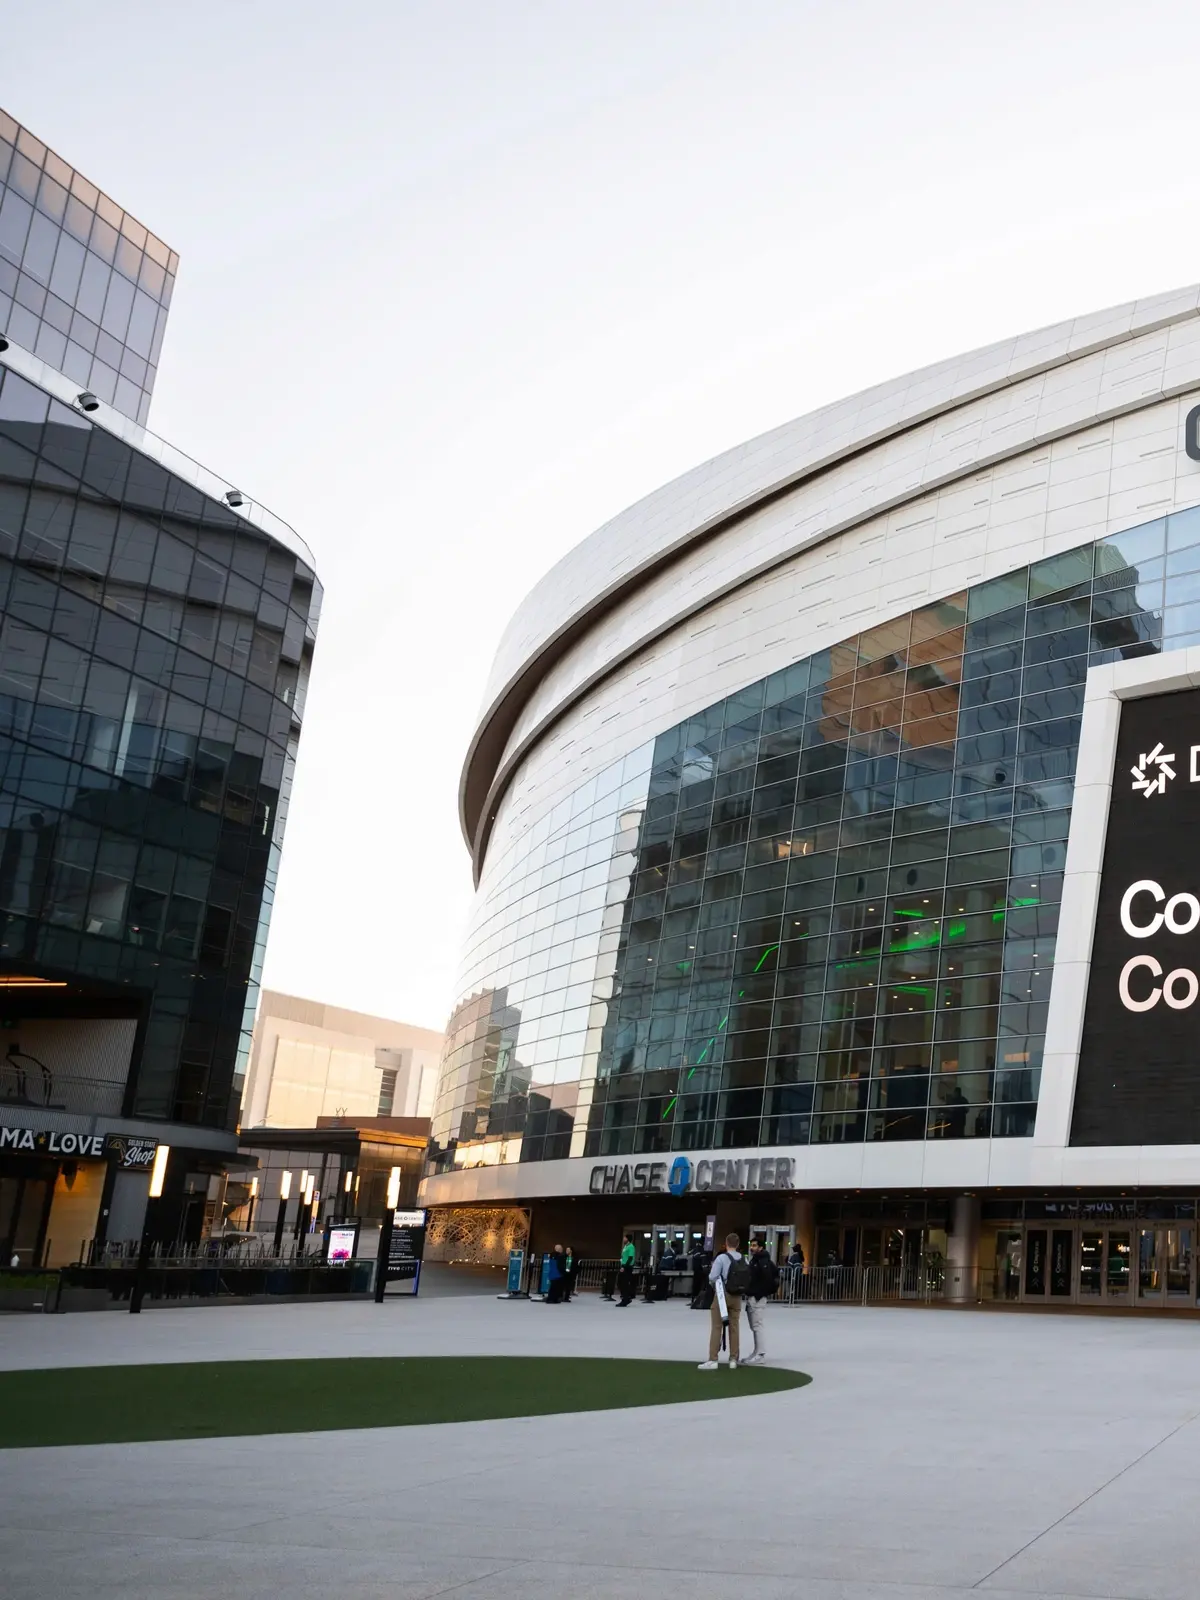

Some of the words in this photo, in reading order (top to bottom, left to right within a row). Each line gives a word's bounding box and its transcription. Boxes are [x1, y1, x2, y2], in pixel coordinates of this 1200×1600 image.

[48, 1132, 104, 1156] LOVE
[123, 1146, 156, 1167] Shop
[589, 1162, 668, 1194] CHASE
[696, 1157, 796, 1191] CENTER
